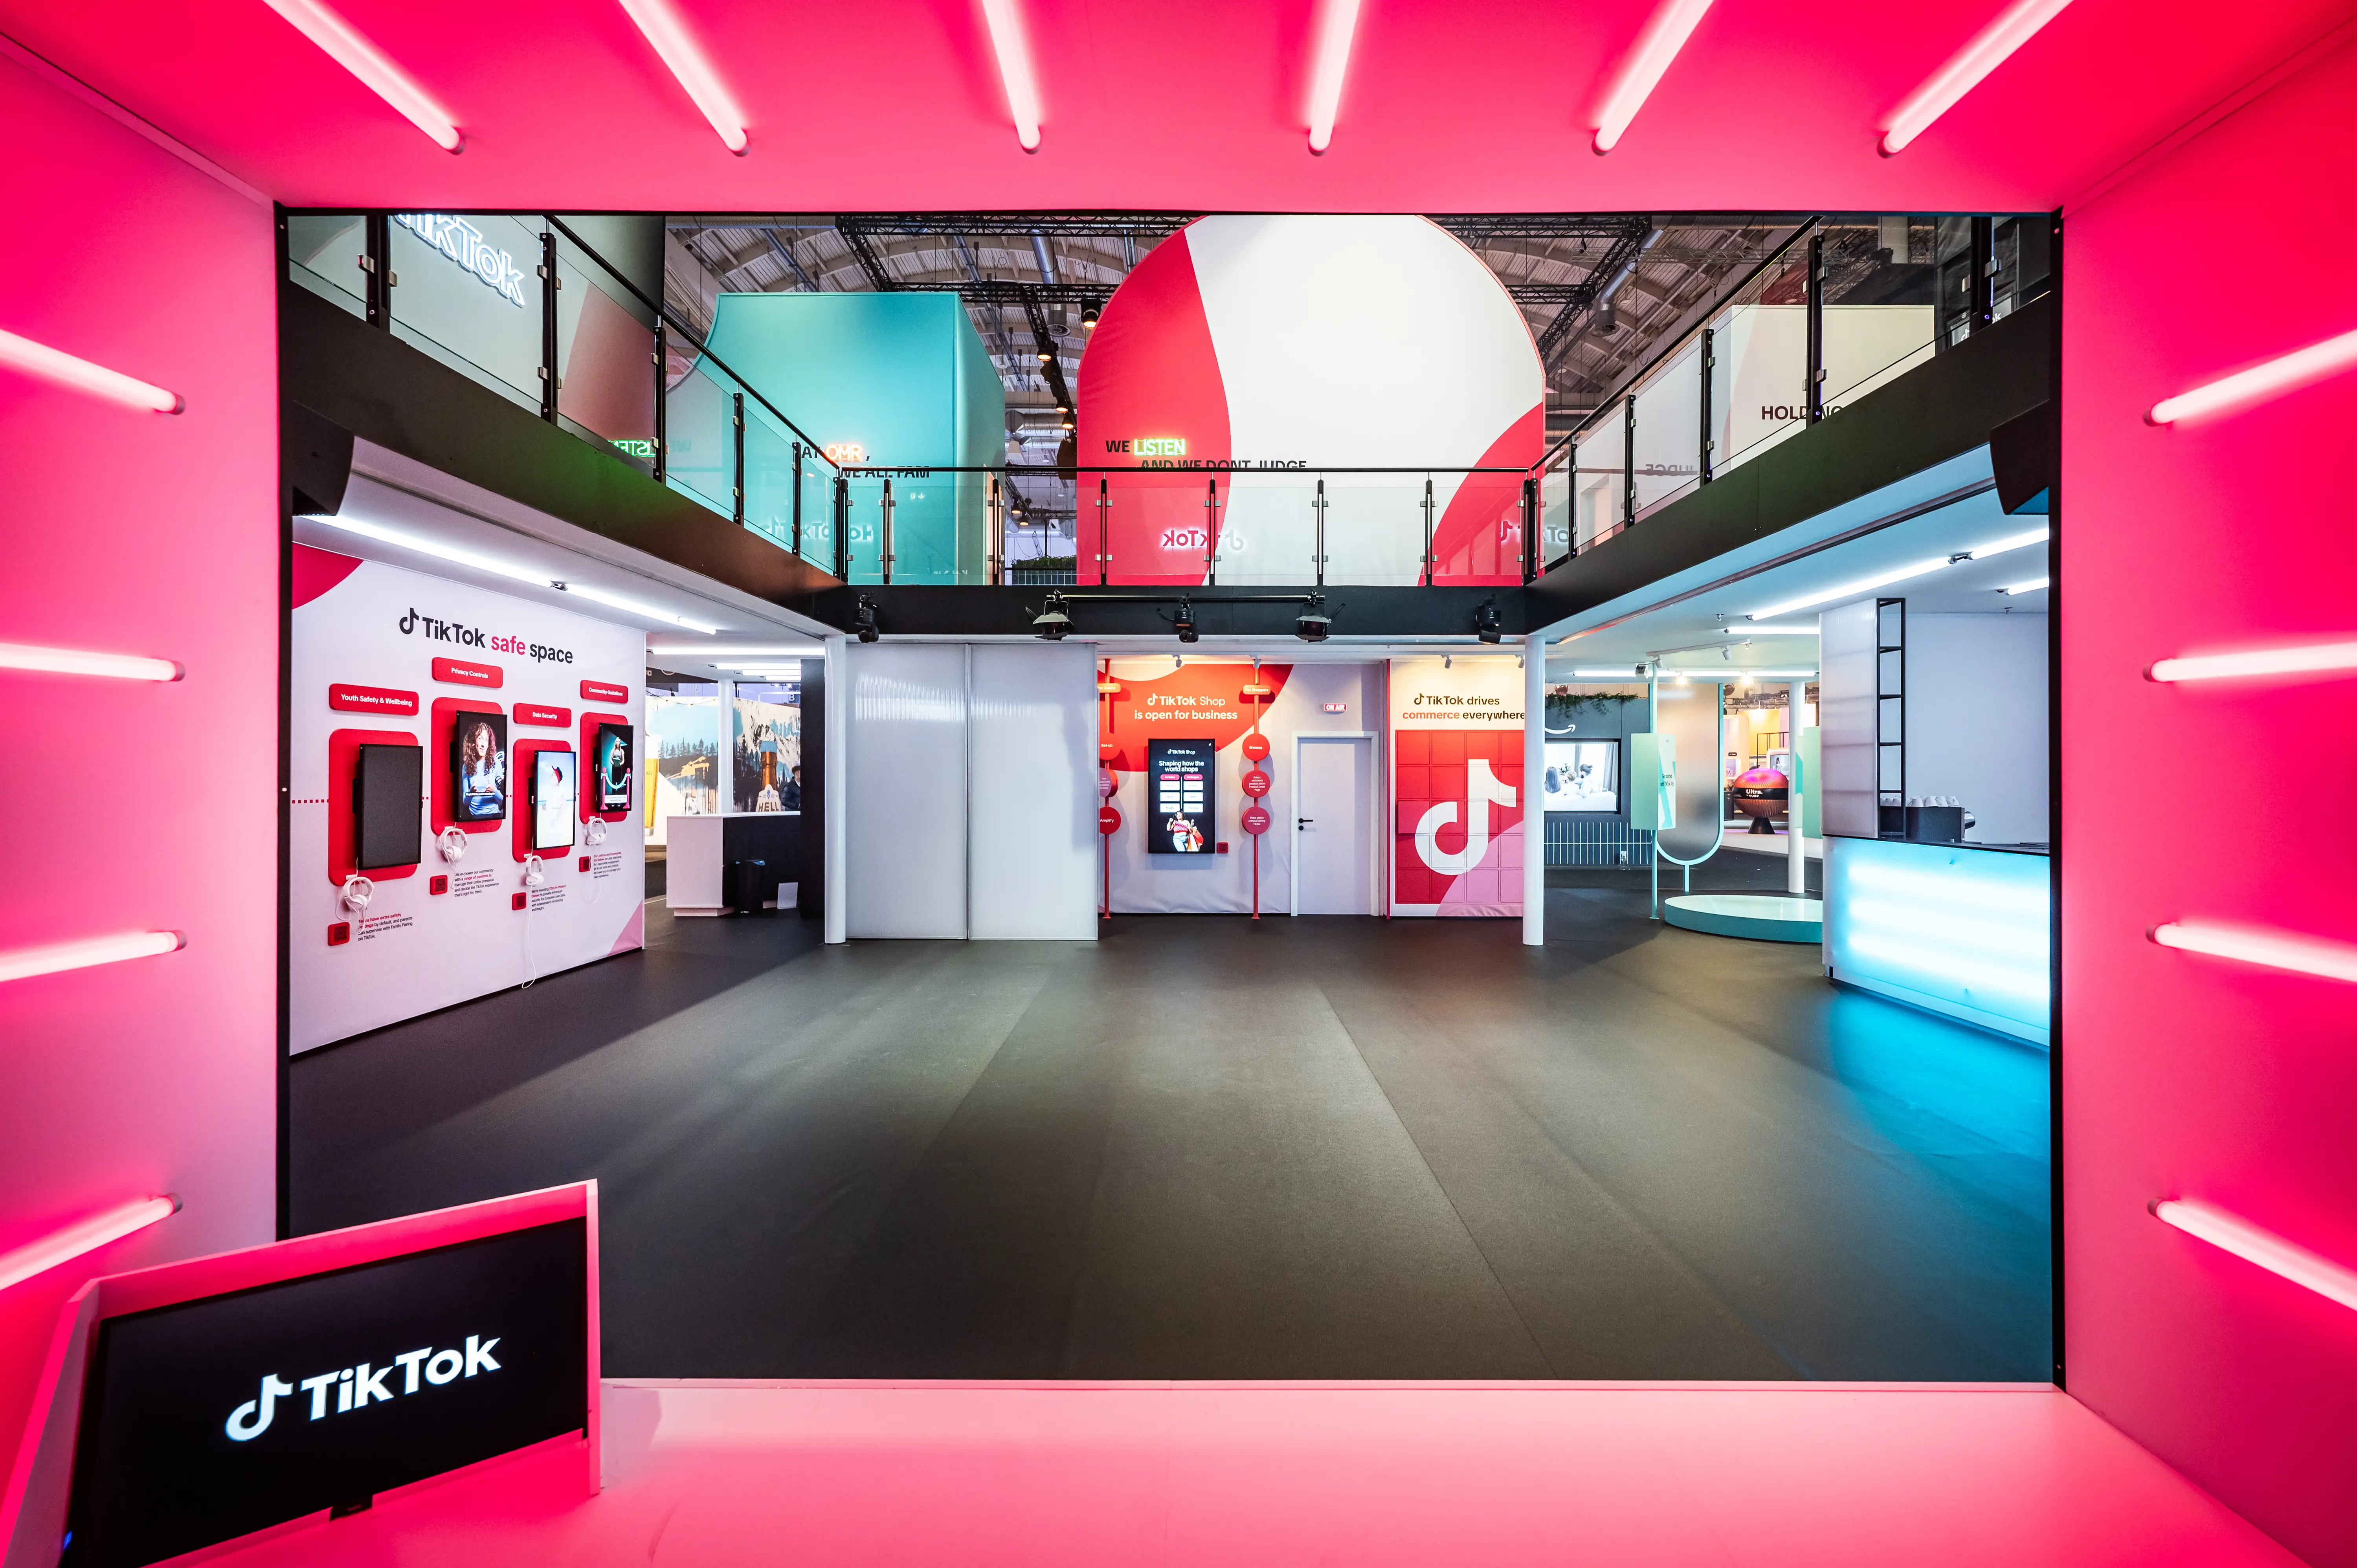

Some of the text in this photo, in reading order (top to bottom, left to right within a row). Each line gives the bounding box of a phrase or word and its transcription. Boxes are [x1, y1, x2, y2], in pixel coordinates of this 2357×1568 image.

[825, 444, 862, 460] OMR
[1105, 439, 1185, 455] WE LISTEN
[422, 617, 573, 663] TikTok safe space
[451, 668, 488, 679] Privacy Controls
[341, 694, 358, 702] Youth
[360, 695, 378, 704] Safety
[385, 697, 412, 707] Wellbeing
[1159, 696, 1225, 707] TikTok Shop
[1426, 696, 1500, 705] TikTok drives
[1134, 710, 1237, 721] is open for business
[1463, 710, 1524, 721] everywhere
[758, 802, 779, 812] HELL
[300, 1335, 502, 1421] TikTok
